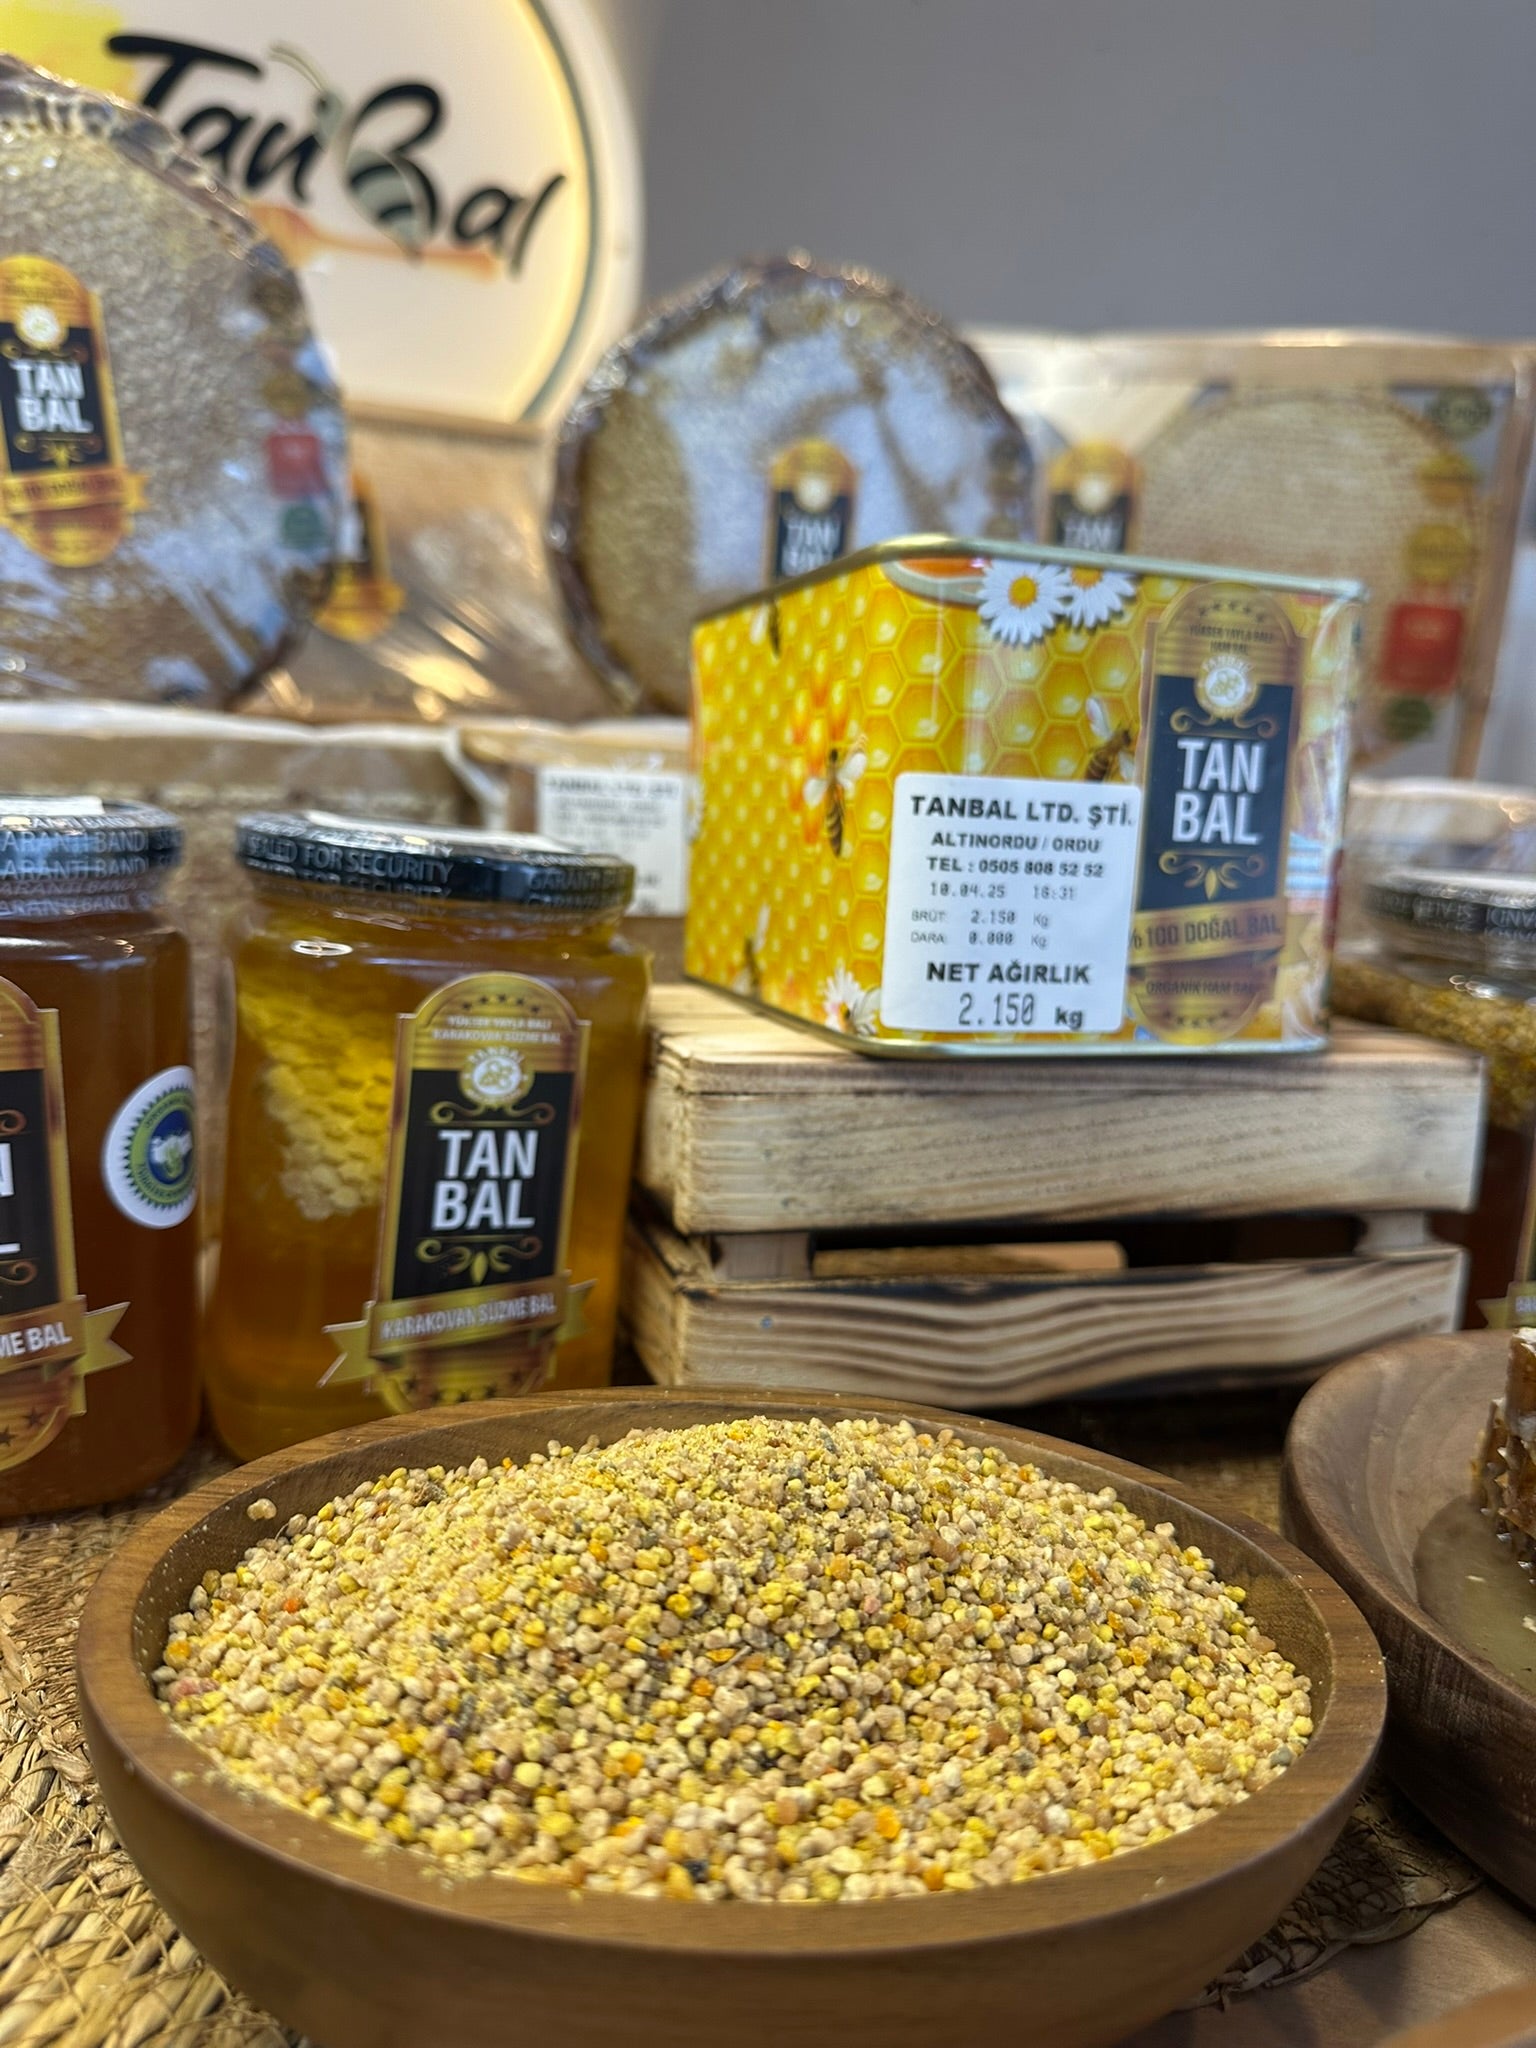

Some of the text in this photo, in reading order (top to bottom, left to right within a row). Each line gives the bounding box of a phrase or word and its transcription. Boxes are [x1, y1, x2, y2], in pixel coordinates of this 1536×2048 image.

[9, 359, 86, 399] TAN
[15, 396, 94, 434] BAL
[1177, 738, 1265, 793] TAN
[910, 795, 1133, 830] TANBAL LTD. ŞTİ.
[1171, 790, 1262, 845] BAL
[931, 832, 1038, 851] ALTINORDU
[1052, 837, 1101, 853] ORDU
[303, 843, 343, 871] FOR
[344, 850, 454, 884] SECURITY
[926, 857, 962, 872] TEL
[978, 859, 1019, 875] 0505
[1024, 861, 1053, 876] 808
[1058, 863, 1078, 877] 52
[1083, 864, 1104, 878] 52
[930, 881, 1006, 899] 10.04.25
[970, 909, 1015, 924] 2.150
[1033, 911, 1049, 928] Kg
[1184, 914, 1243, 945] DOĞAL
[1247, 913, 1281, 939] BAL
[1031, 934, 1047, 948] Kg
[926, 958, 1091, 984] NET AĞIRLIK
[958, 992, 1084, 1030] 2.150 kg
[438, 1129, 539, 1179] TAN
[431, 1179, 536, 1231] BAL
[380, 1308, 476, 1341] KARAKOVAN
[529, 1291, 558, 1316] BAL
[0, 1321, 74, 1358] ME BAL
